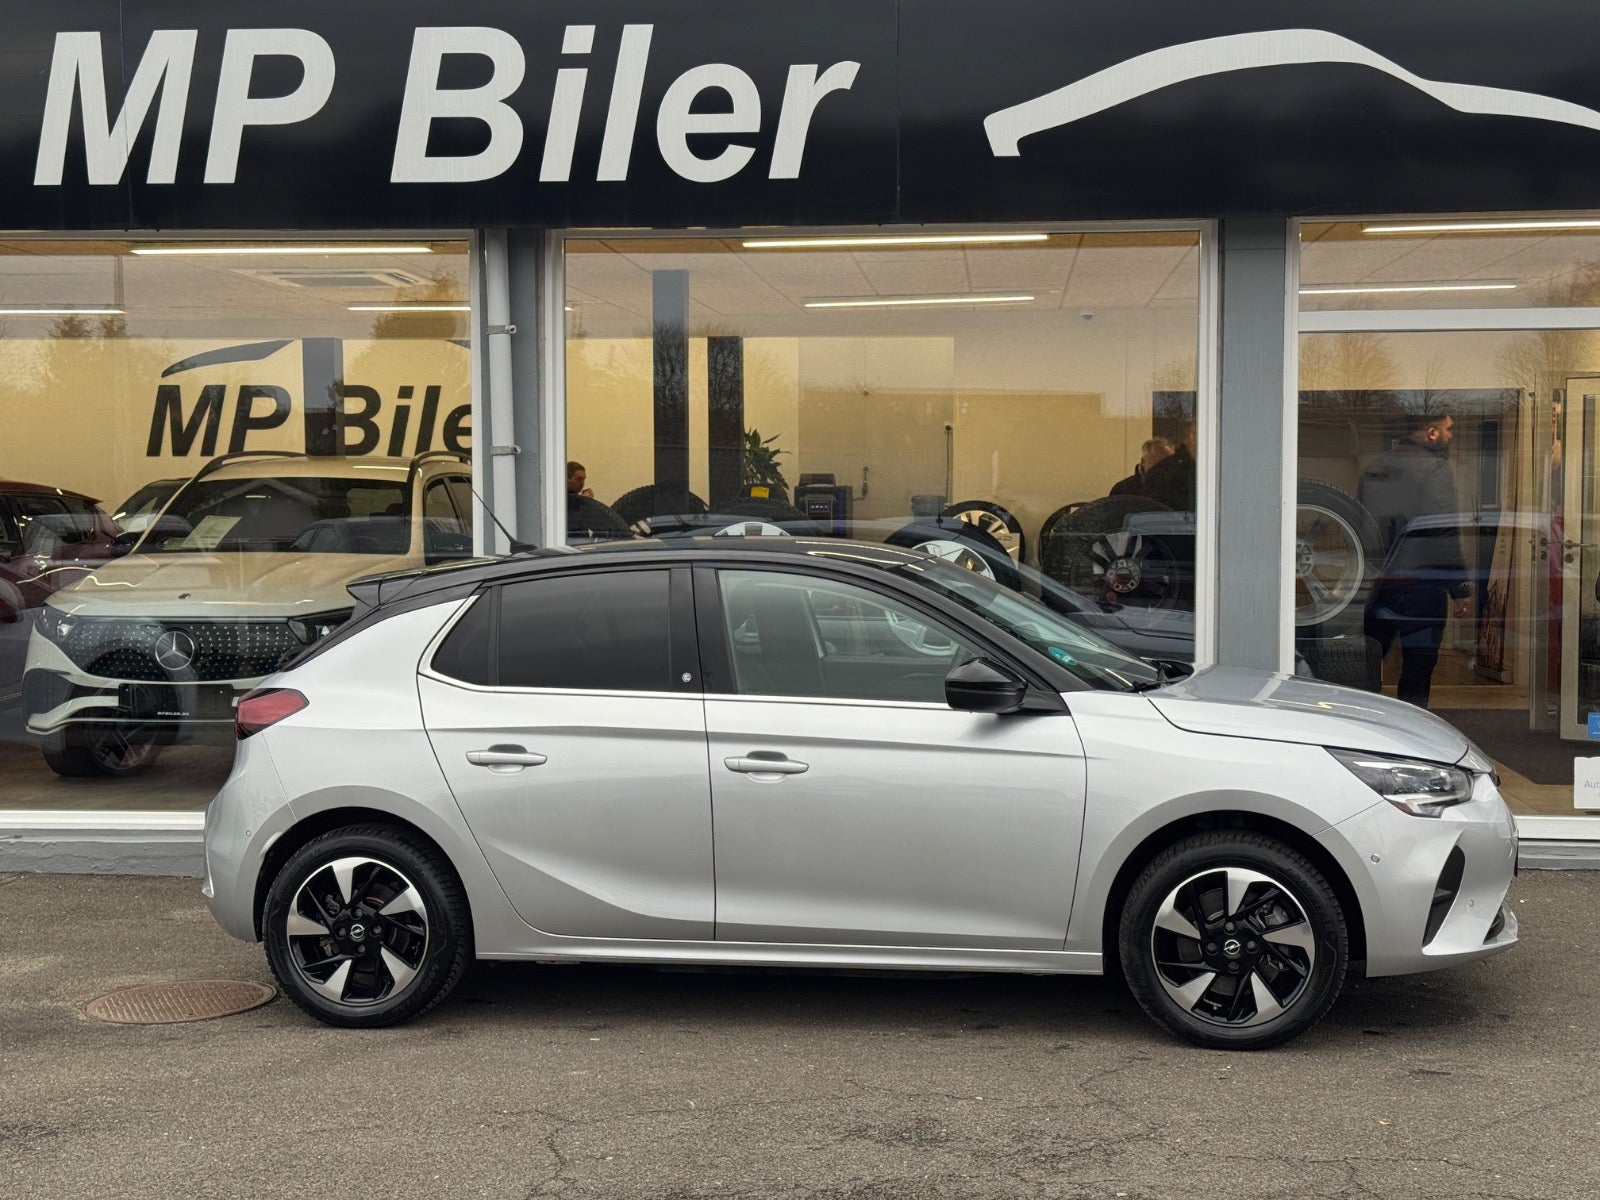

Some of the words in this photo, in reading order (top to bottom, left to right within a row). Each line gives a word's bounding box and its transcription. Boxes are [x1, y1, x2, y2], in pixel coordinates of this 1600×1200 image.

[34, 28, 336, 185] MP
[391, 24, 861, 182] Biler
[146, 384, 292, 457] MP
